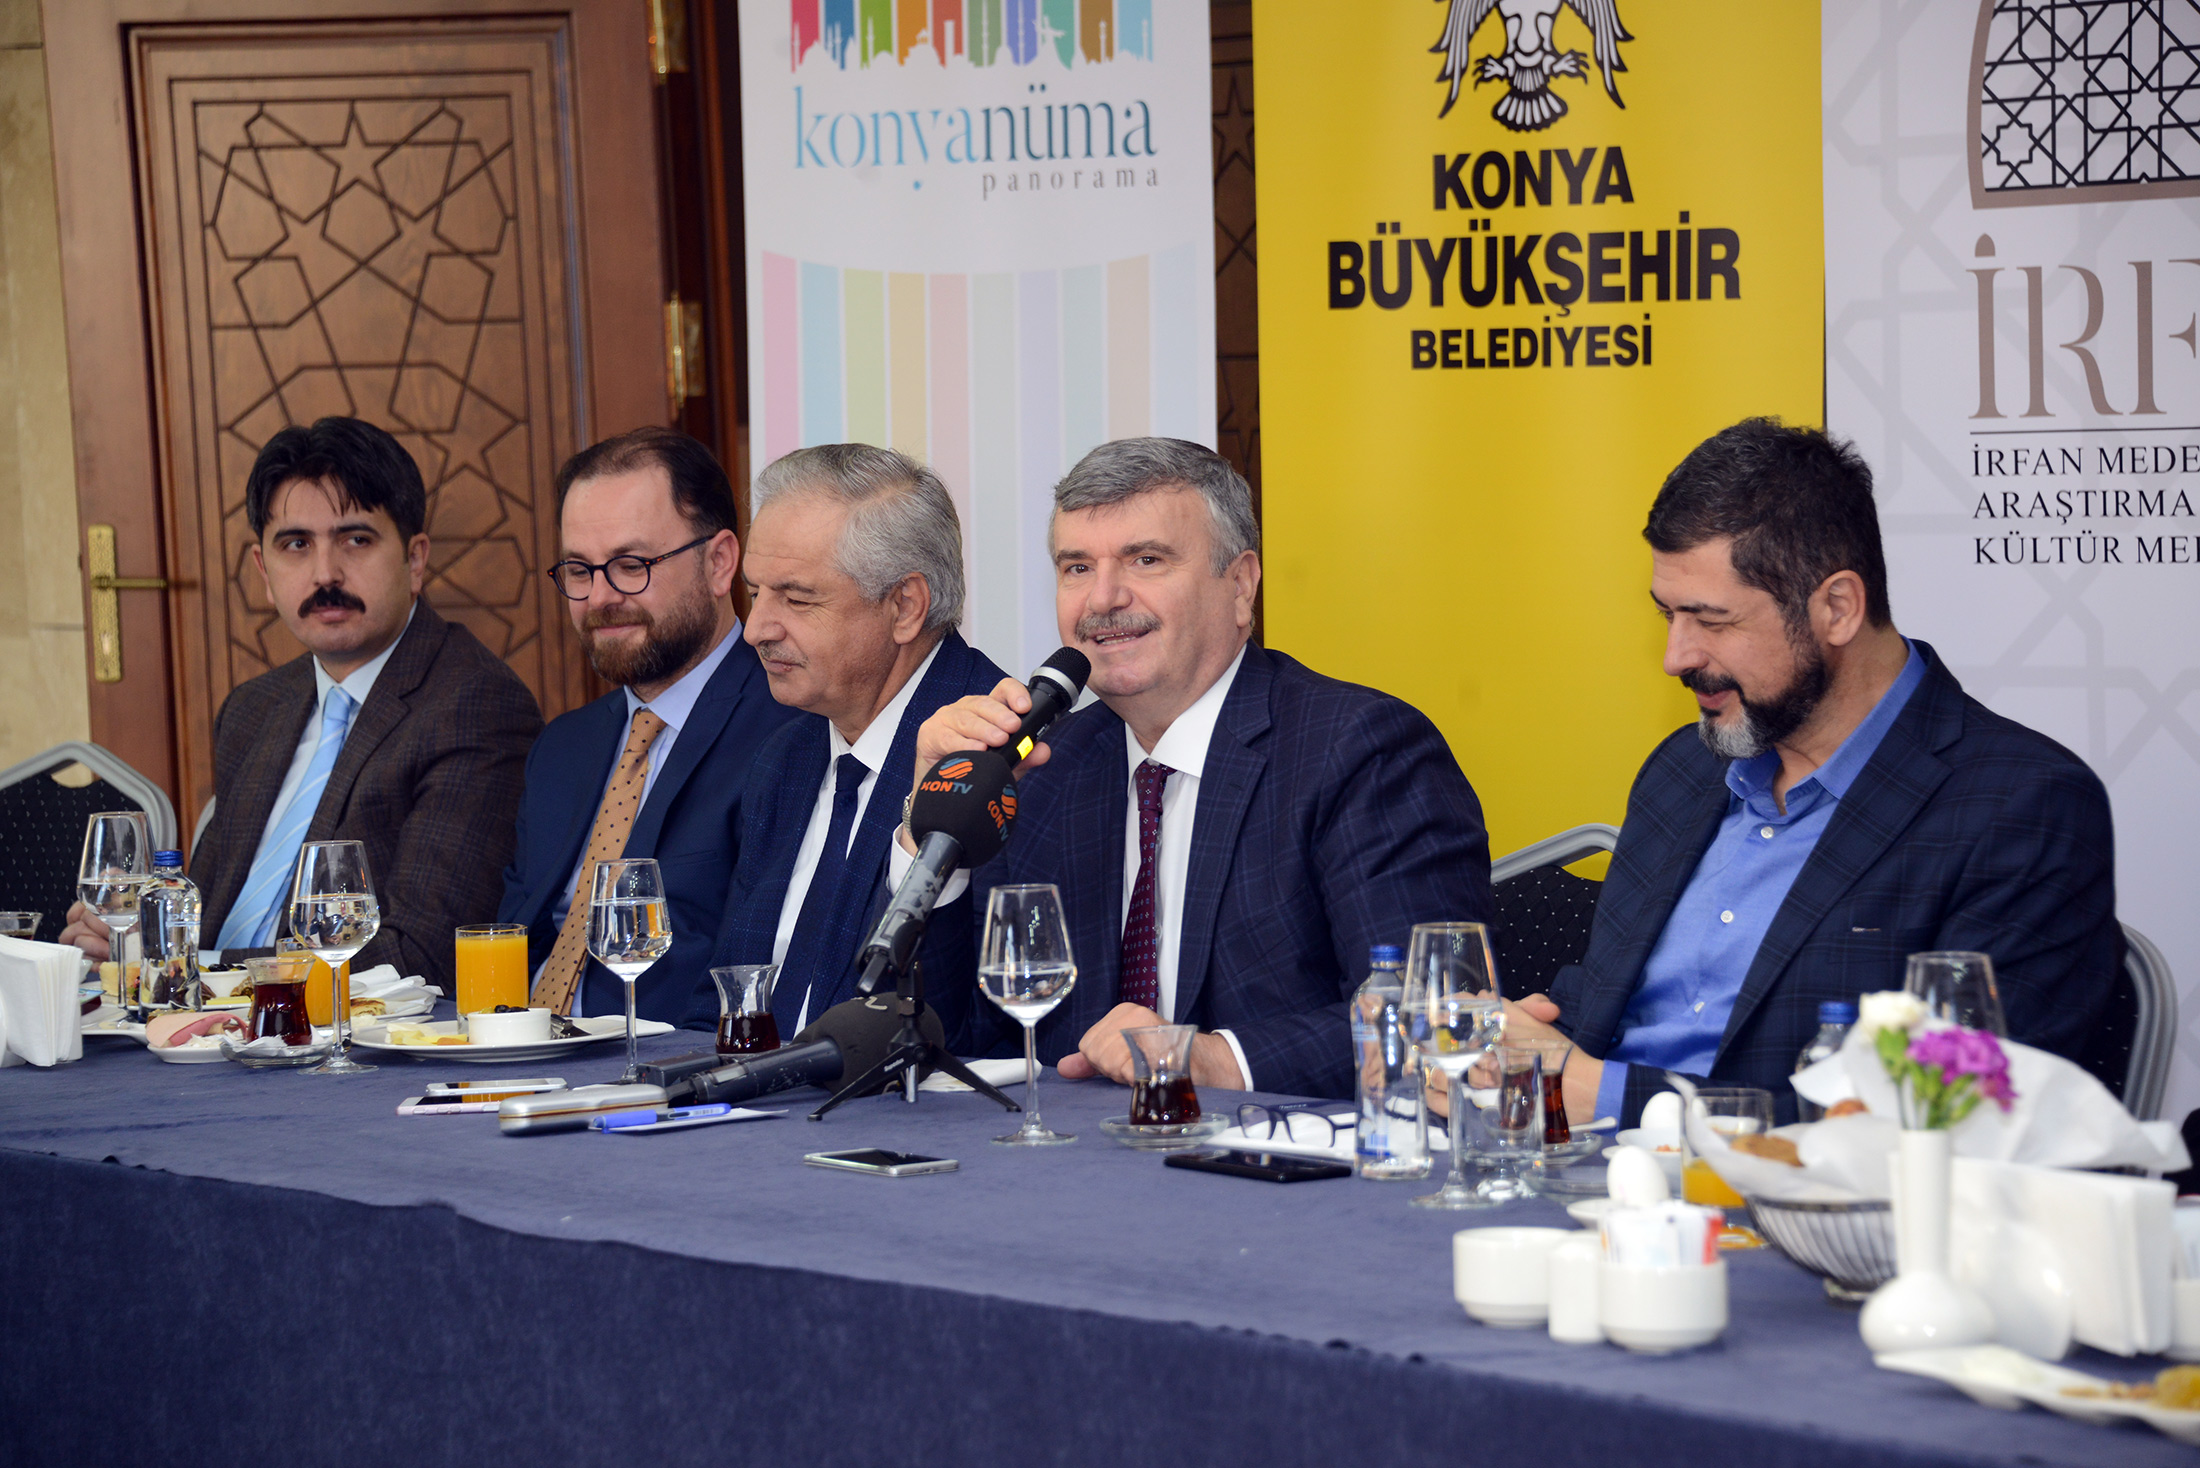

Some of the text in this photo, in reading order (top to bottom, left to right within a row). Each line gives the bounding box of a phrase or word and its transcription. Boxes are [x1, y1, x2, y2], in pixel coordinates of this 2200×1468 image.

[982, 166, 1160, 201] panorama
[1432, 146, 1635, 211] KONYA
[1327, 210, 1742, 316] BÜYÜKŞEHİR
[1411, 313, 1653, 370] BELEDİYESİ
[1971, 444, 2200, 477] İRFAN MEDE
[1972, 488, 2197, 525] ARAŞTIRMA
[1973, 530, 2124, 565] KÜLTÜR
